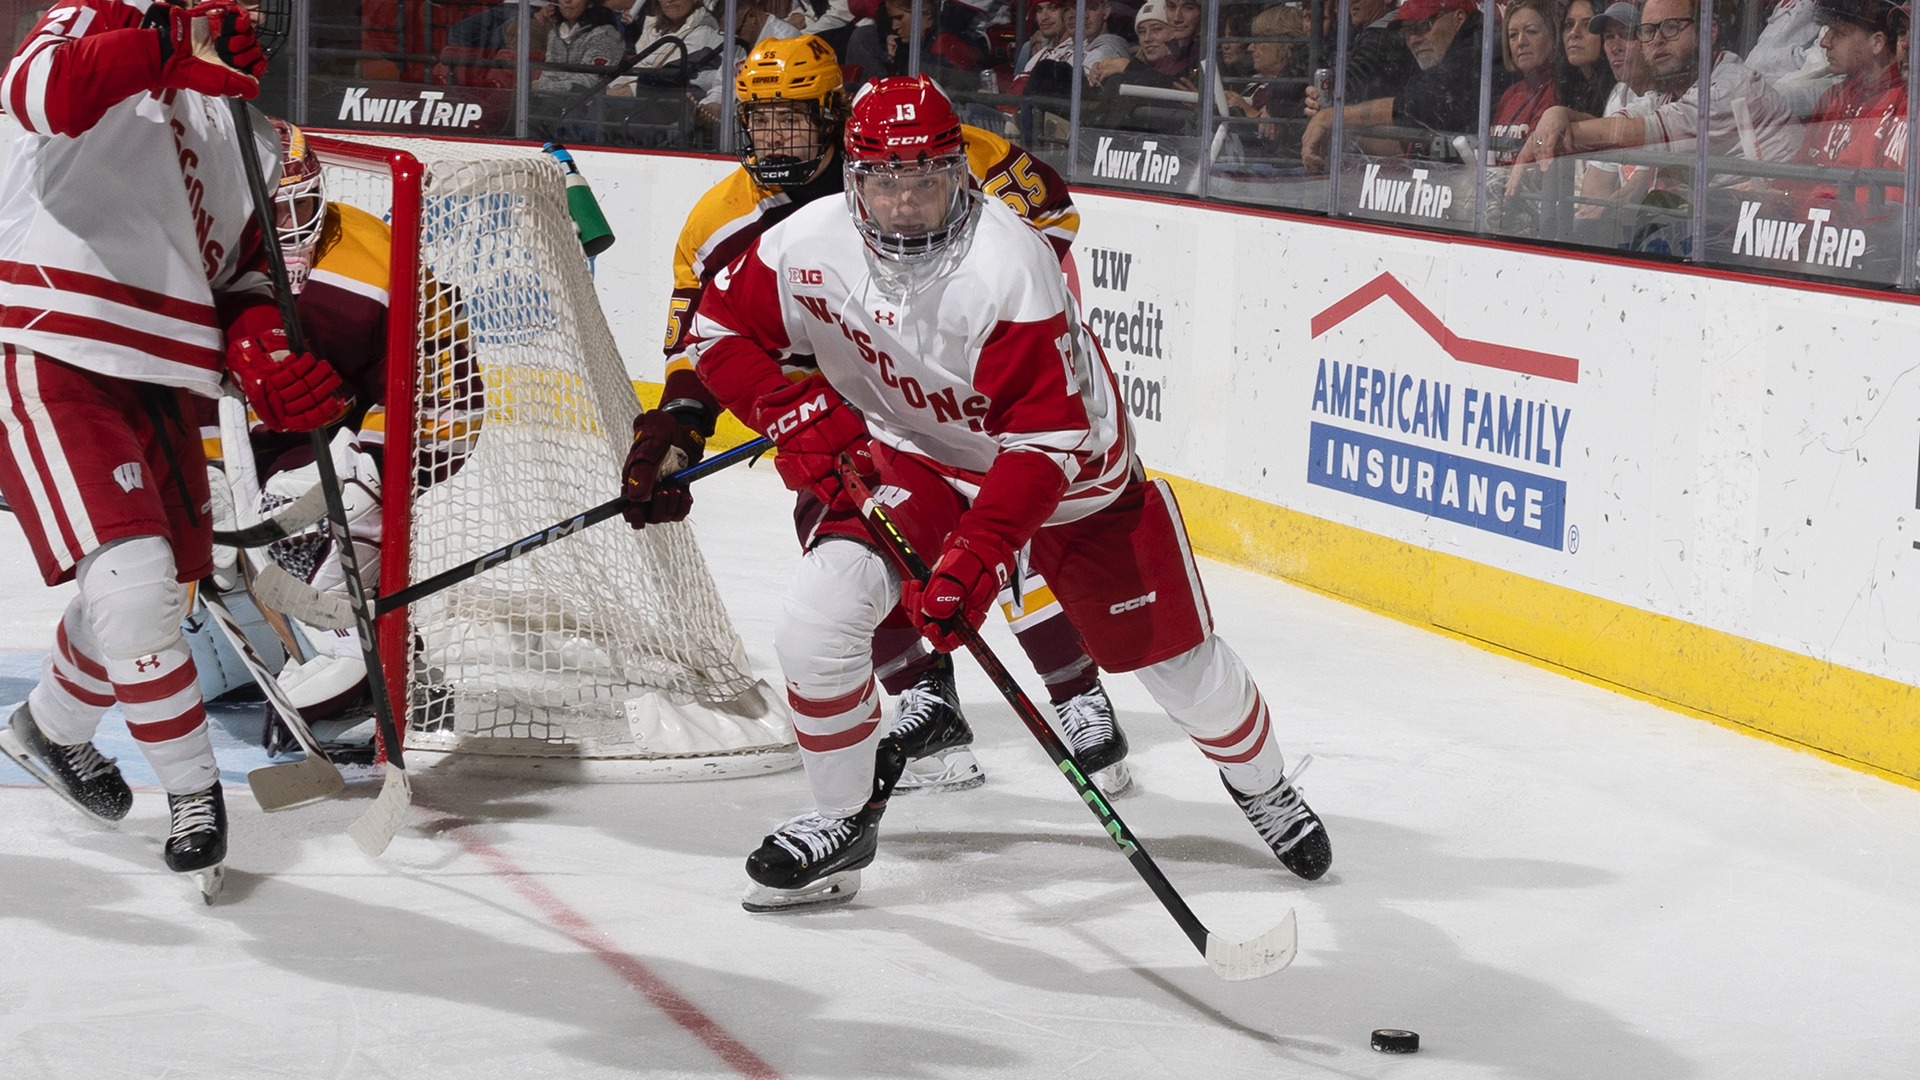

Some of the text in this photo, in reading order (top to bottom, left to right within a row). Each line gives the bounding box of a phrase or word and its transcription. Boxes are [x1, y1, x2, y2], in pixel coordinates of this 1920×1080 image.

[763, 51, 776, 59] 55
[752, 75, 780, 85] GOPHERS
[895, 103, 916, 121] 13
[887, 134, 929, 146] CCM
[1091, 247, 1132, 292] uw
[1088, 301, 1163, 360] credit
[1113, 361, 1163, 423] ion
[1311, 357, 1572, 469] AMERICAN FAMILY
[766, 393, 829, 441] CCM
[112, 461, 145, 494] W
[1326, 438, 1544, 531] INSURANCE
[474, 515, 586, 575] CCM
[1109, 591, 1157, 615] CCM
